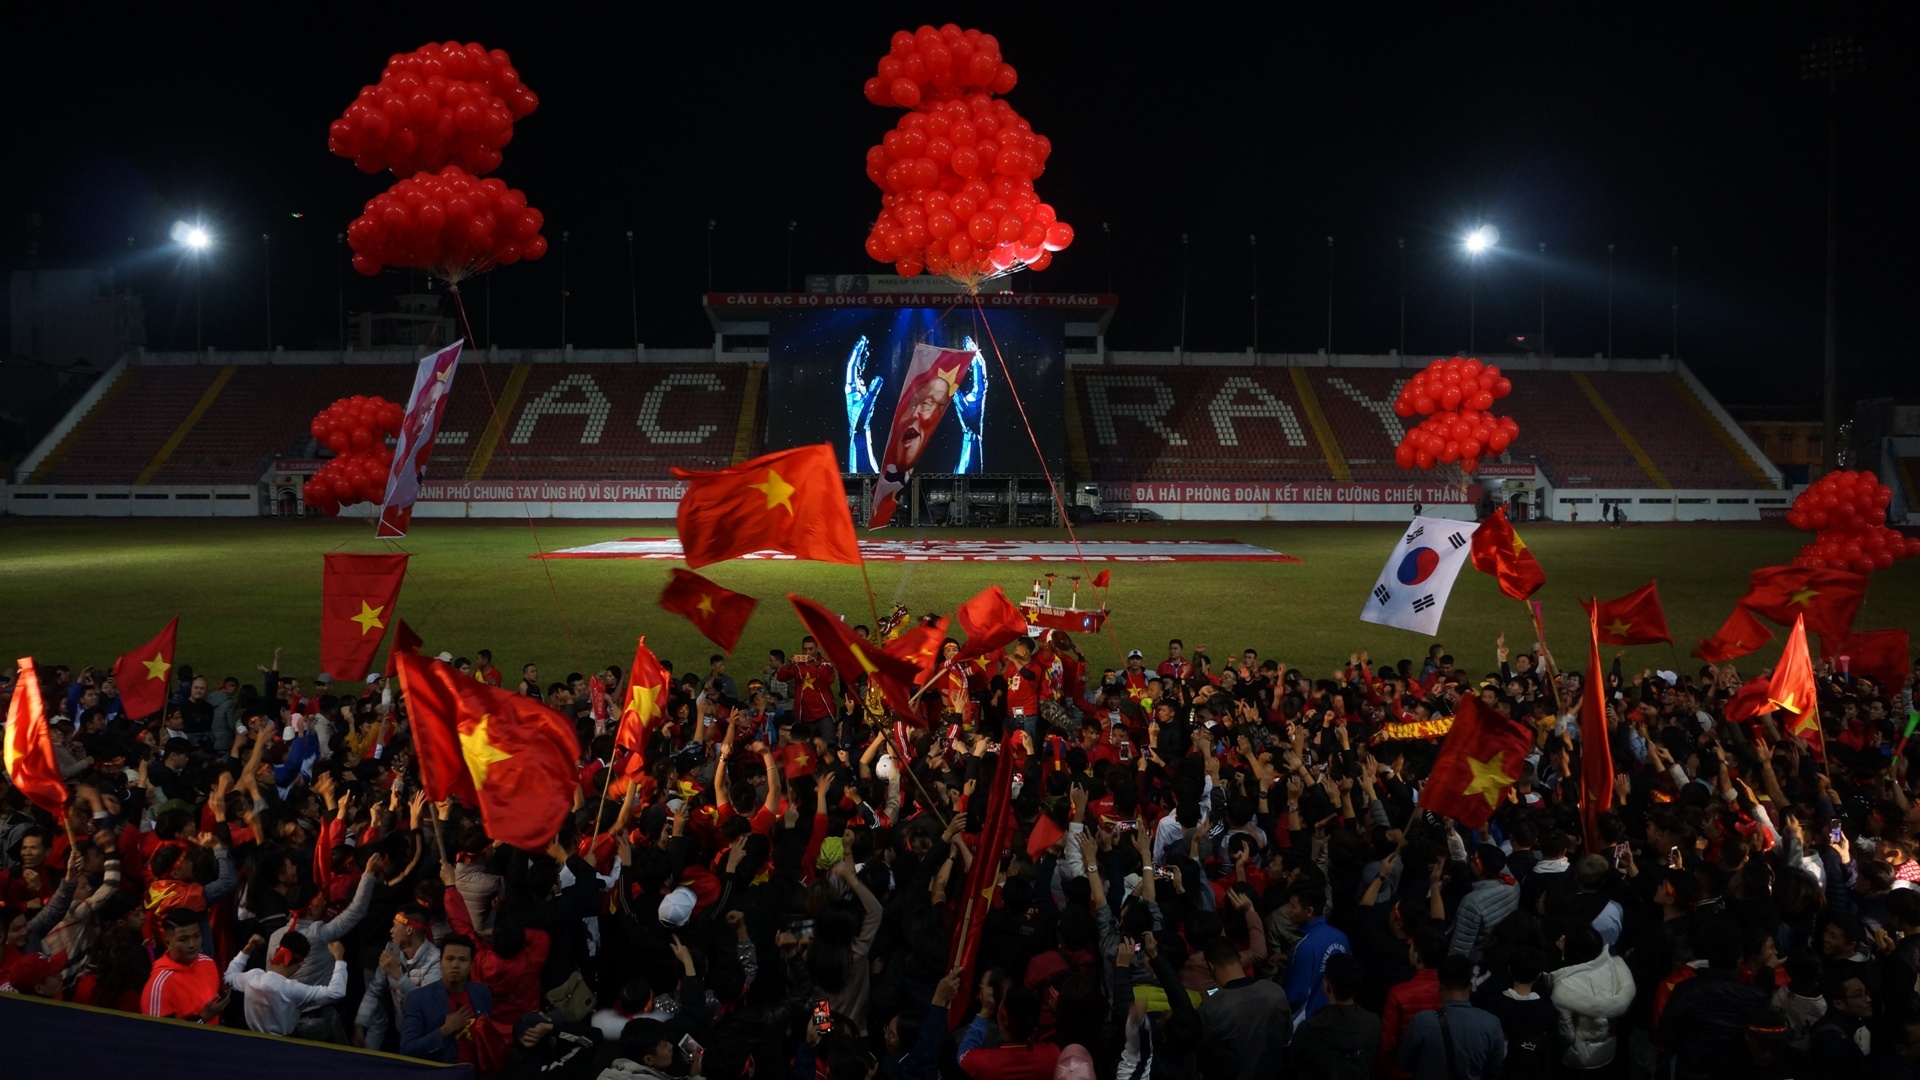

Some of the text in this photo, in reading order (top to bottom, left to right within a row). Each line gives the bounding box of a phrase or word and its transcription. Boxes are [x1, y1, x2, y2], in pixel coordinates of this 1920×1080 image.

[764, 296, 792, 306] LẠC
[798, 295, 819, 306] BỘ
[825, 295, 867, 304] BÓNG
[872, 295, 894, 304] ĐÁ
[900, 295, 926, 304] HẢI
[991, 295, 1041, 305] QUYẾT
[1048, 294, 1099, 305] THẮNG
[447, 482, 470, 499] PHỐ
[474, 486, 514, 499] CHUNG
[516, 487, 539, 499] TAY
[542, 483, 566, 499] ỦNG
[569, 484, 586, 502] HỘ
[589, 484, 600, 499] VÌ
[603, 485, 620, 502] SỰ
[622, 484, 653, 499] PHÁT
[1100, 485, 1131, 501] ÓNG
[1136, 485, 1155, 501] ĐÁ
[1159, 484, 1181, 501] HẢI
[1186, 485, 1230, 501] PHÒNG
[1235, 485, 1270, 501] ĐOÀN
[1275, 483, 1298, 501] KẾT
[1303, 485, 1332, 501] KIÊN
[1336, 485, 1380, 501] CƯỜNG
[1384, 484, 1422, 501] CHIẾN
